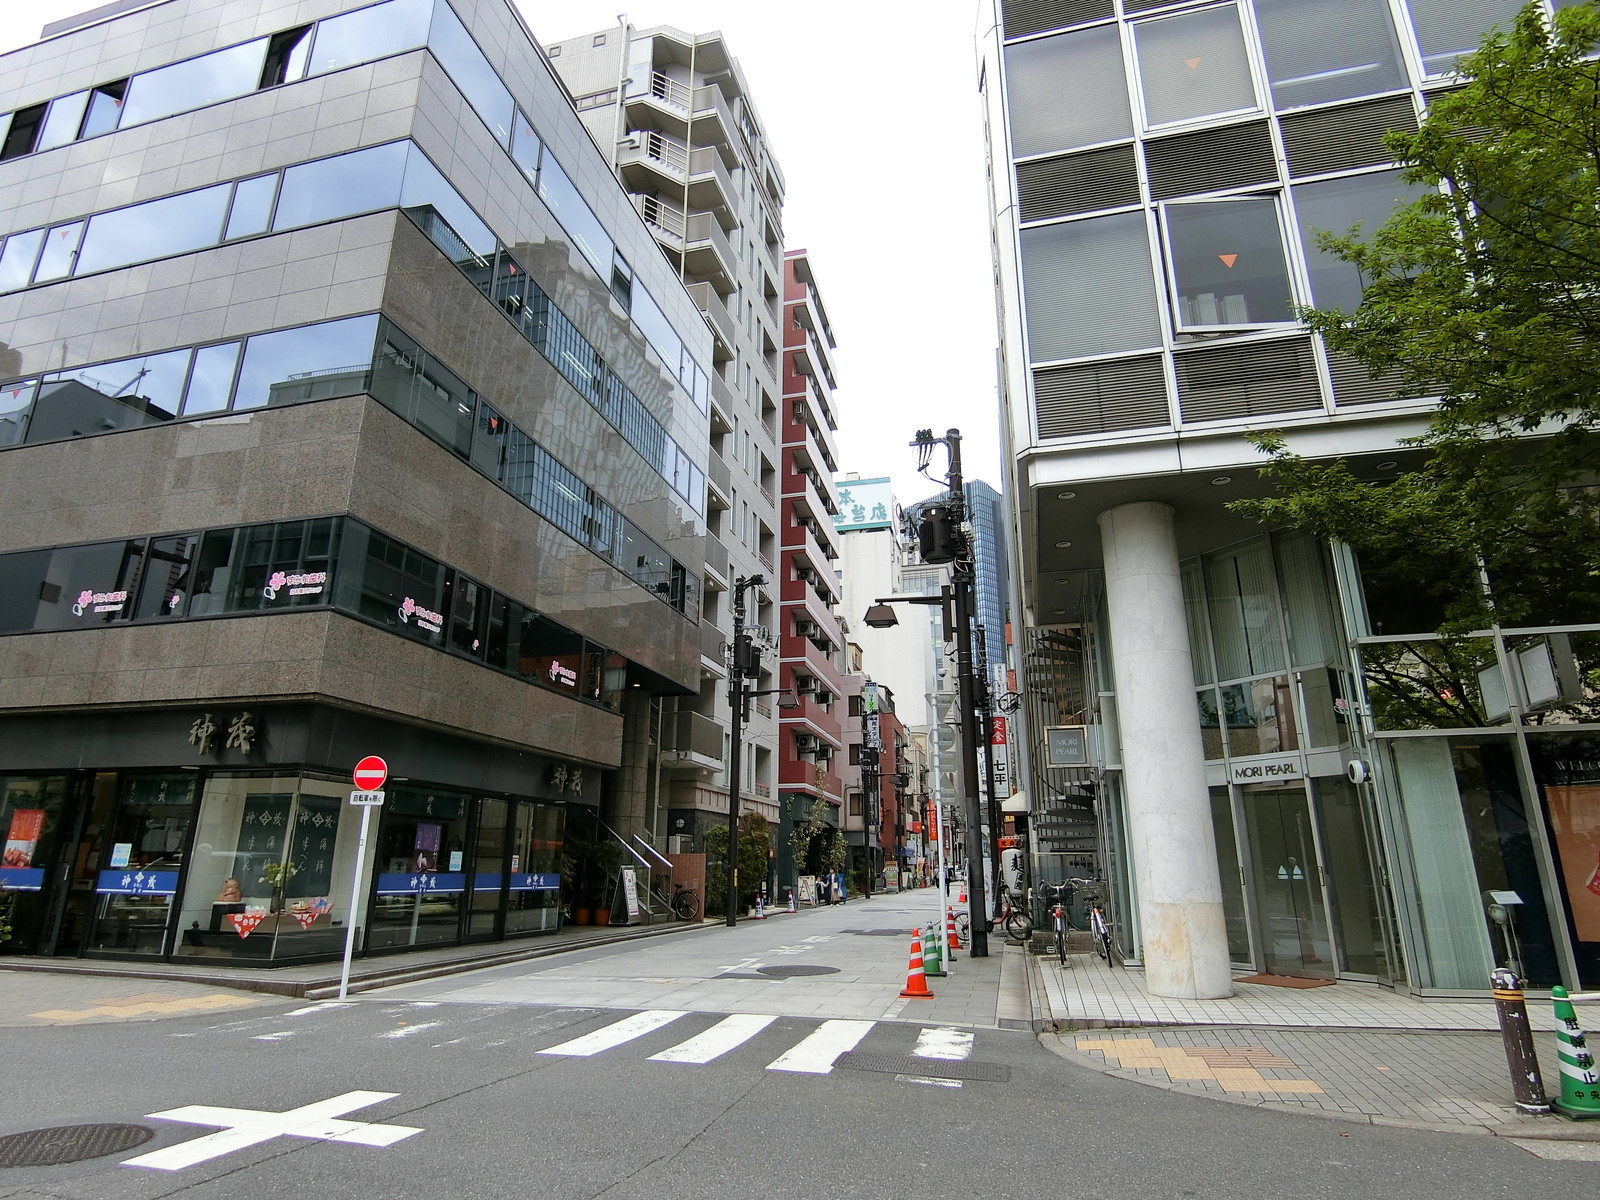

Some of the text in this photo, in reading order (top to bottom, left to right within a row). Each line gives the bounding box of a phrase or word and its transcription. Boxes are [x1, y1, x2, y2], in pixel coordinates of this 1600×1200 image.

[188, 711, 256, 755] 神茂
[992, 719, 1005, 742] 定食
[1055, 747, 1079, 755] PEARL
[1056, 738, 1078, 746] MORI
[551, 764, 583, 797] 神茂
[993, 759, 1006, 785] 七平
[1235, 762, 1297, 779] MORI PEARL
[353, 794, 382, 803] 自転車を除く
